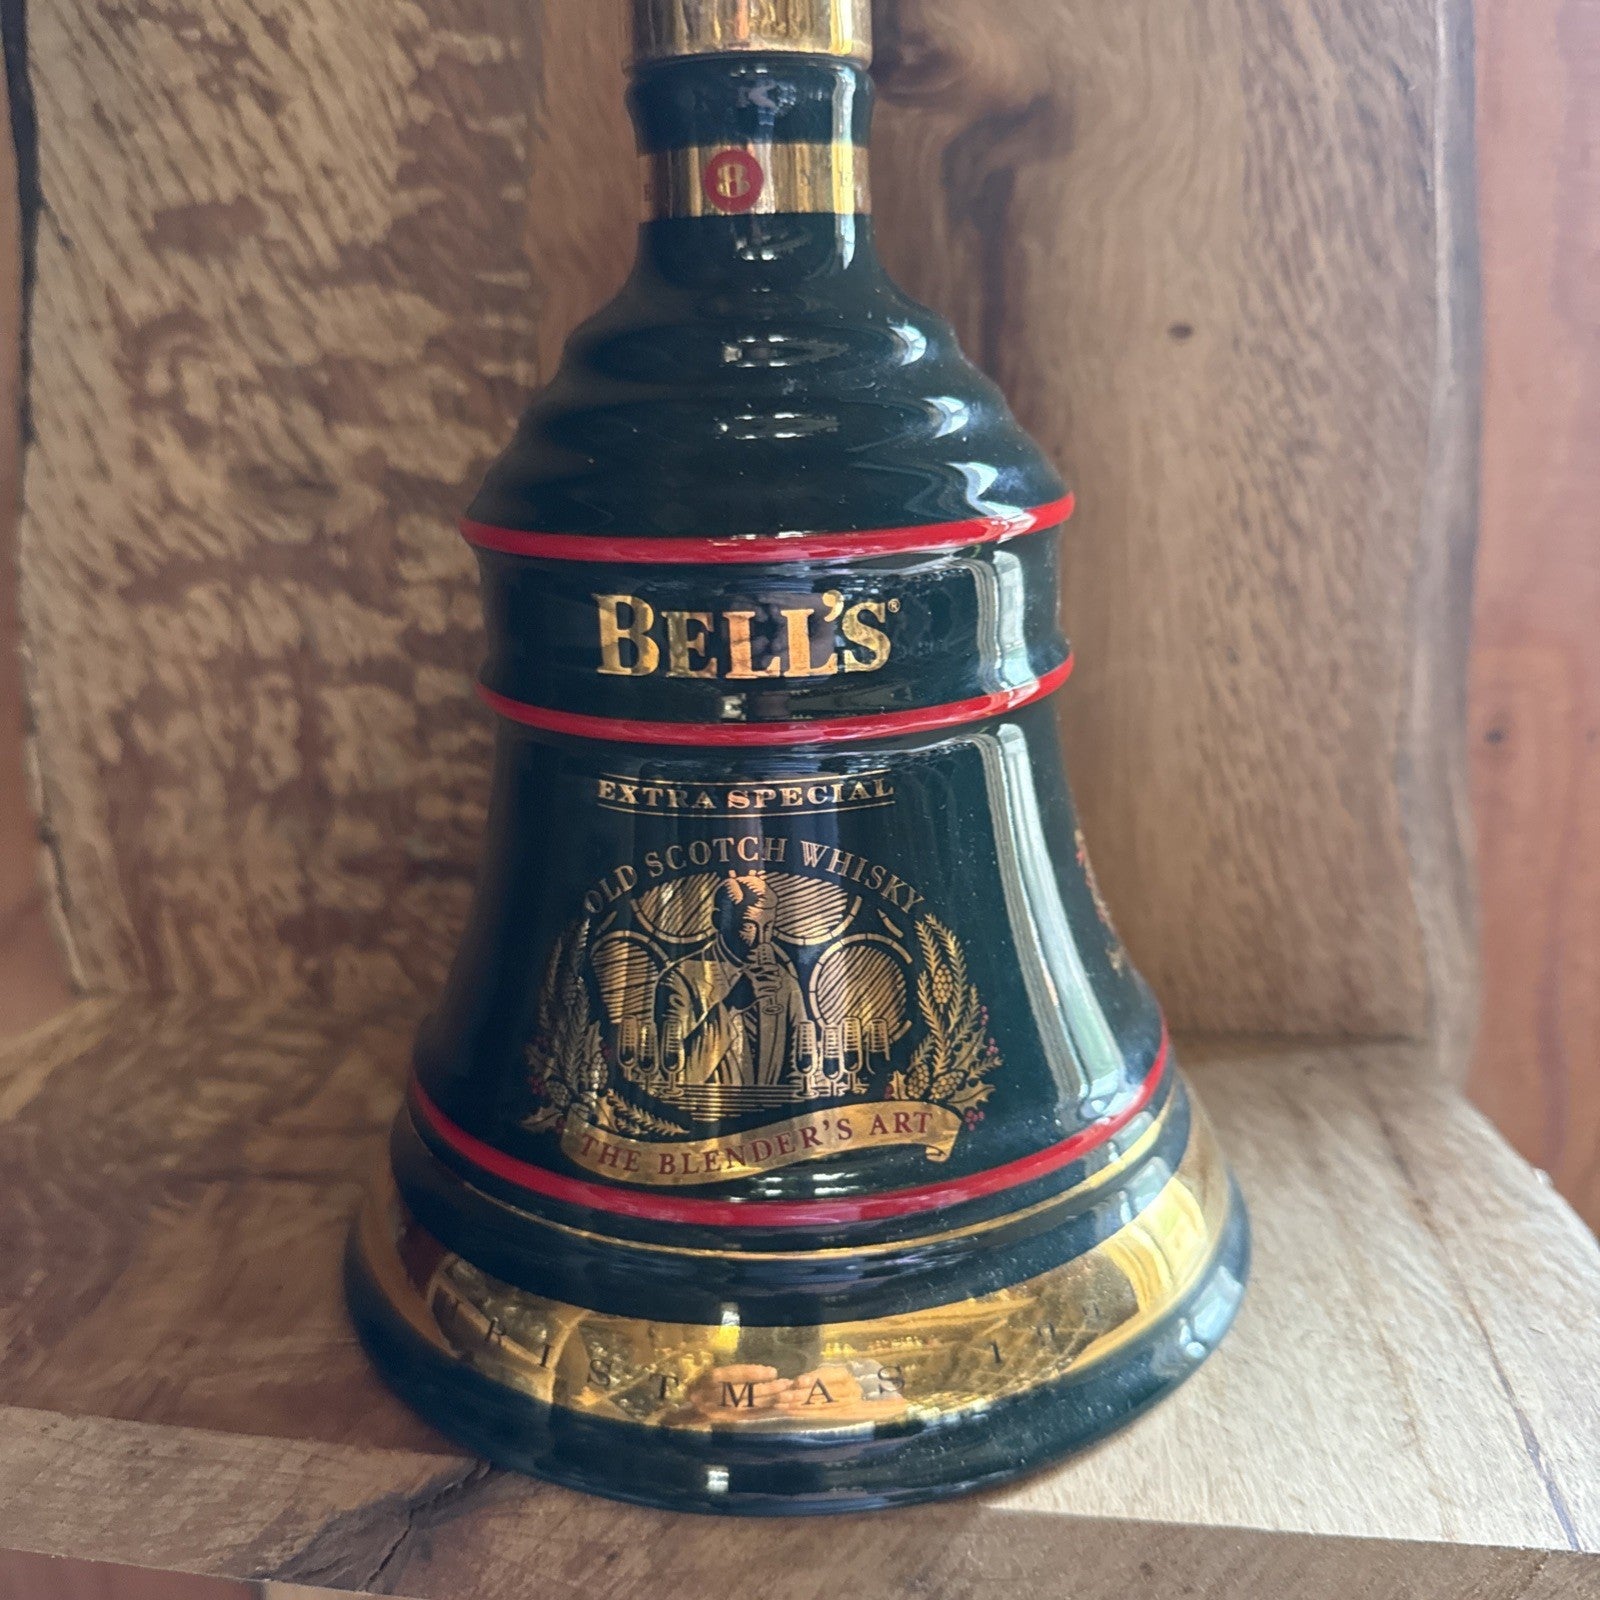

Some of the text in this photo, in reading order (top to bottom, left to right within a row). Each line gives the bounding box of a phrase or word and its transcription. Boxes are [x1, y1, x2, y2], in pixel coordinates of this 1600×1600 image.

[598, 778, 894, 809] EXTRA SPECIAL
[584, 836, 925, 914] OLD SCOTCH WHISKY
[580, 1110, 933, 1175] THE BLENDER'S ART
